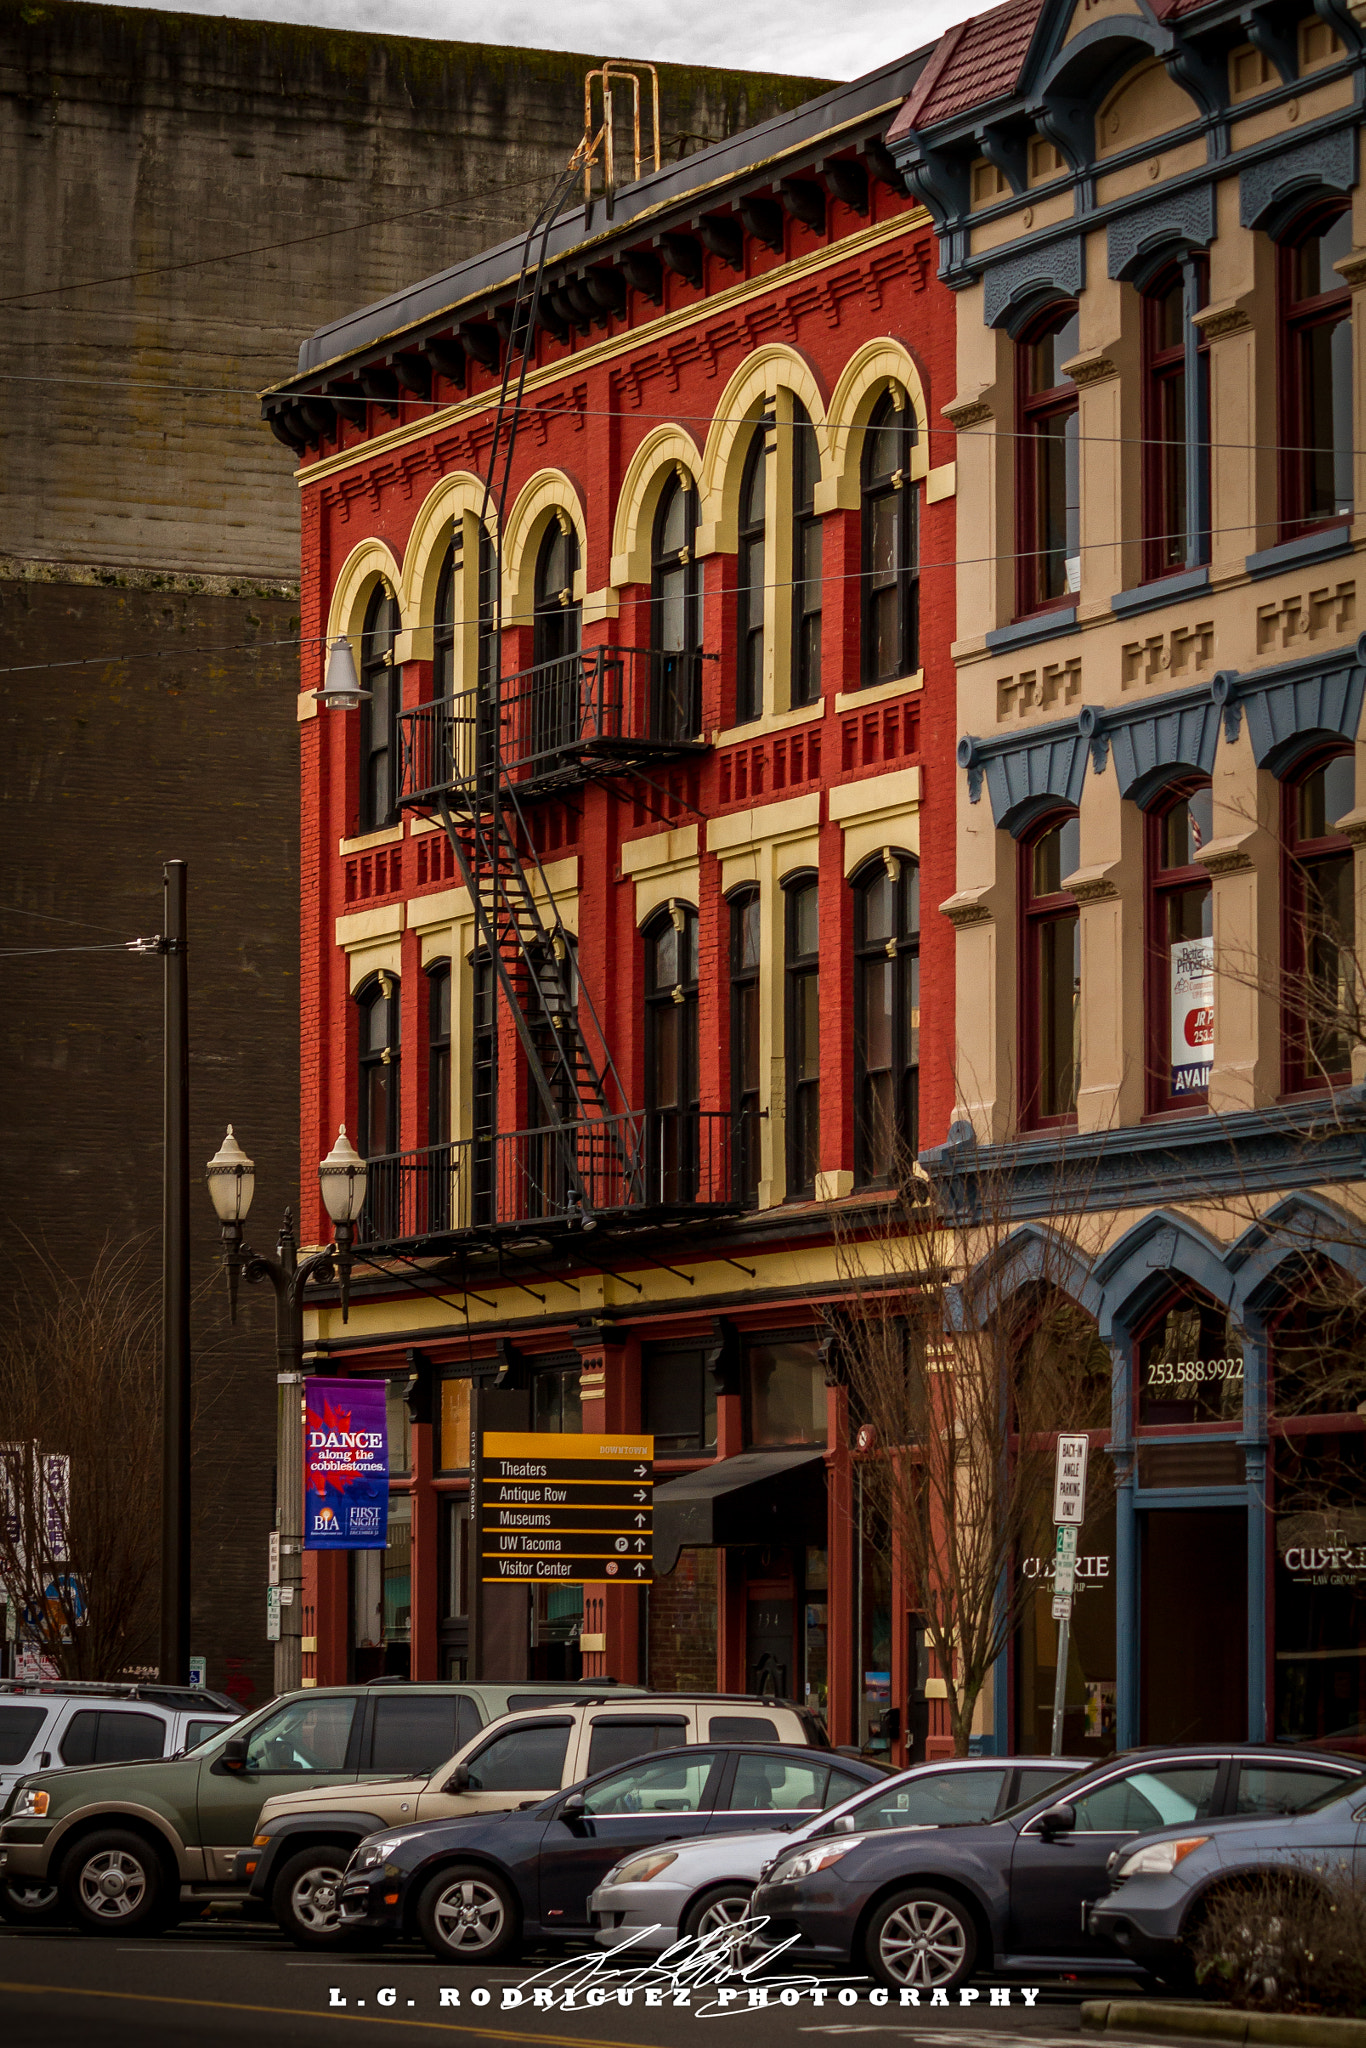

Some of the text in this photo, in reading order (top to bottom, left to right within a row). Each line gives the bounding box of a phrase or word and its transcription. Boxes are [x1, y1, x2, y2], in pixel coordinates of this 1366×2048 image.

[1182, 947, 1205, 961] Better
[1194, 1011, 1206, 1027] JR
[1194, 1028, 1214, 1043] 253.3
[1147, 1358, 1244, 1385] 253.588.9922
[309, 1432, 383, 1448] DANCE
[318, 1449, 374, 1462] along the
[600, 1446, 648, 1455] DOWNTOWN
[1062, 1443, 1083, 1458] BACK-IN
[310, 1460, 386, 1471] cobblestones.
[470, 1459, 476, 1473] OF
[500, 1461, 547, 1476] Theaters
[1063, 1463, 1080, 1477] ANGLE
[500, 1486, 567, 1503] Antique Row
[1060, 1482, 1080, 1497] PARKING
[350, 1507, 382, 1518] FIRST
[1062, 1501, 1075, 1516] ONLY
[314, 1515, 340, 1531] BIA
[349, 1517, 381, 1527] NIGHT
[500, 1510, 551, 1526] Museums
[499, 1535, 519, 1551] UW
[520, 1536, 562, 1551] Tacoma
[499, 1560, 572, 1576] Visitor Center
[1312, 1574, 1329, 1585] LAW
